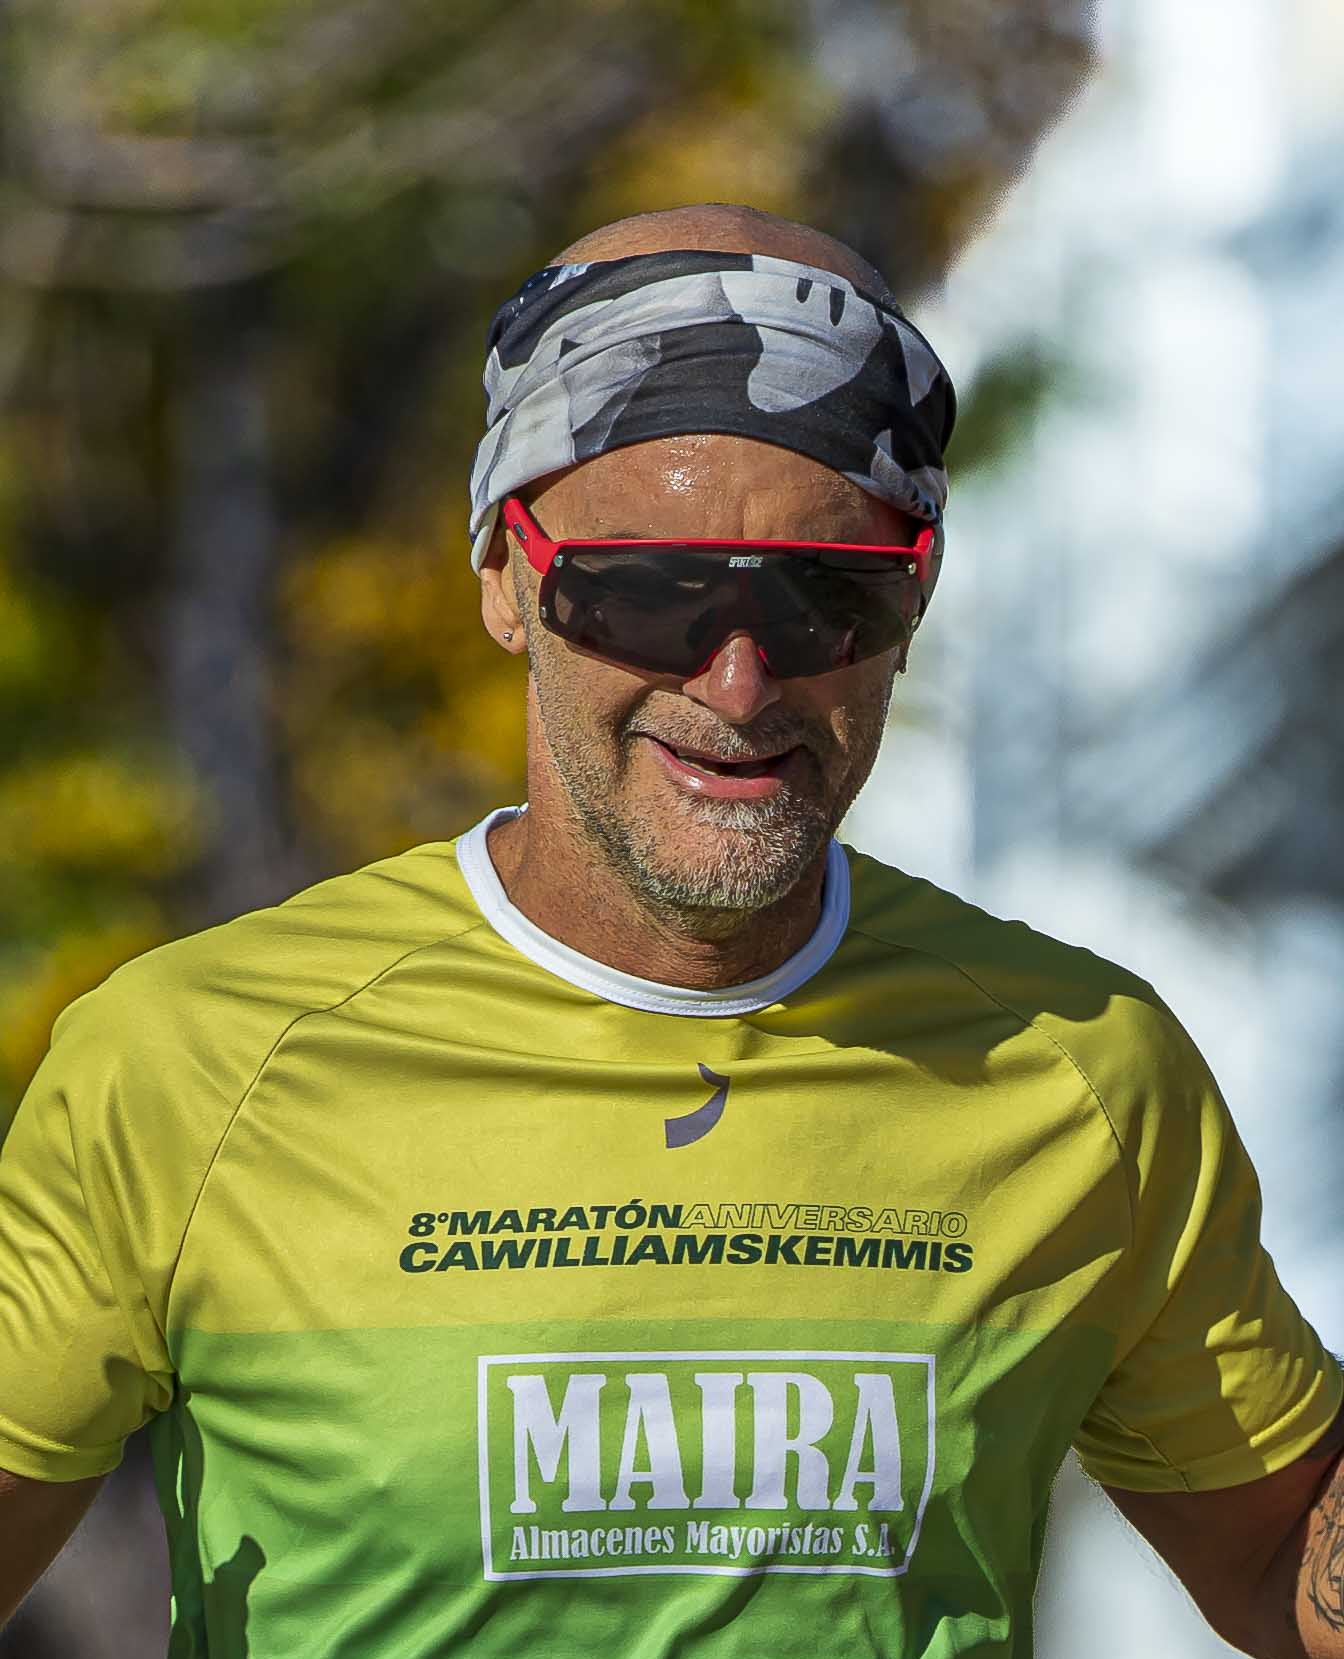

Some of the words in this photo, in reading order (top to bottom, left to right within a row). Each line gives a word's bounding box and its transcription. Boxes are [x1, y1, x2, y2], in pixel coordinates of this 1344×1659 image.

[399, 1233, 974, 1274] CAWILLIAMSKEMMIS
[506, 1372, 905, 1514] MAIRA
[510, 1524, 675, 1561] Almacenes
[685, 1520, 843, 1560] Mayoristas
